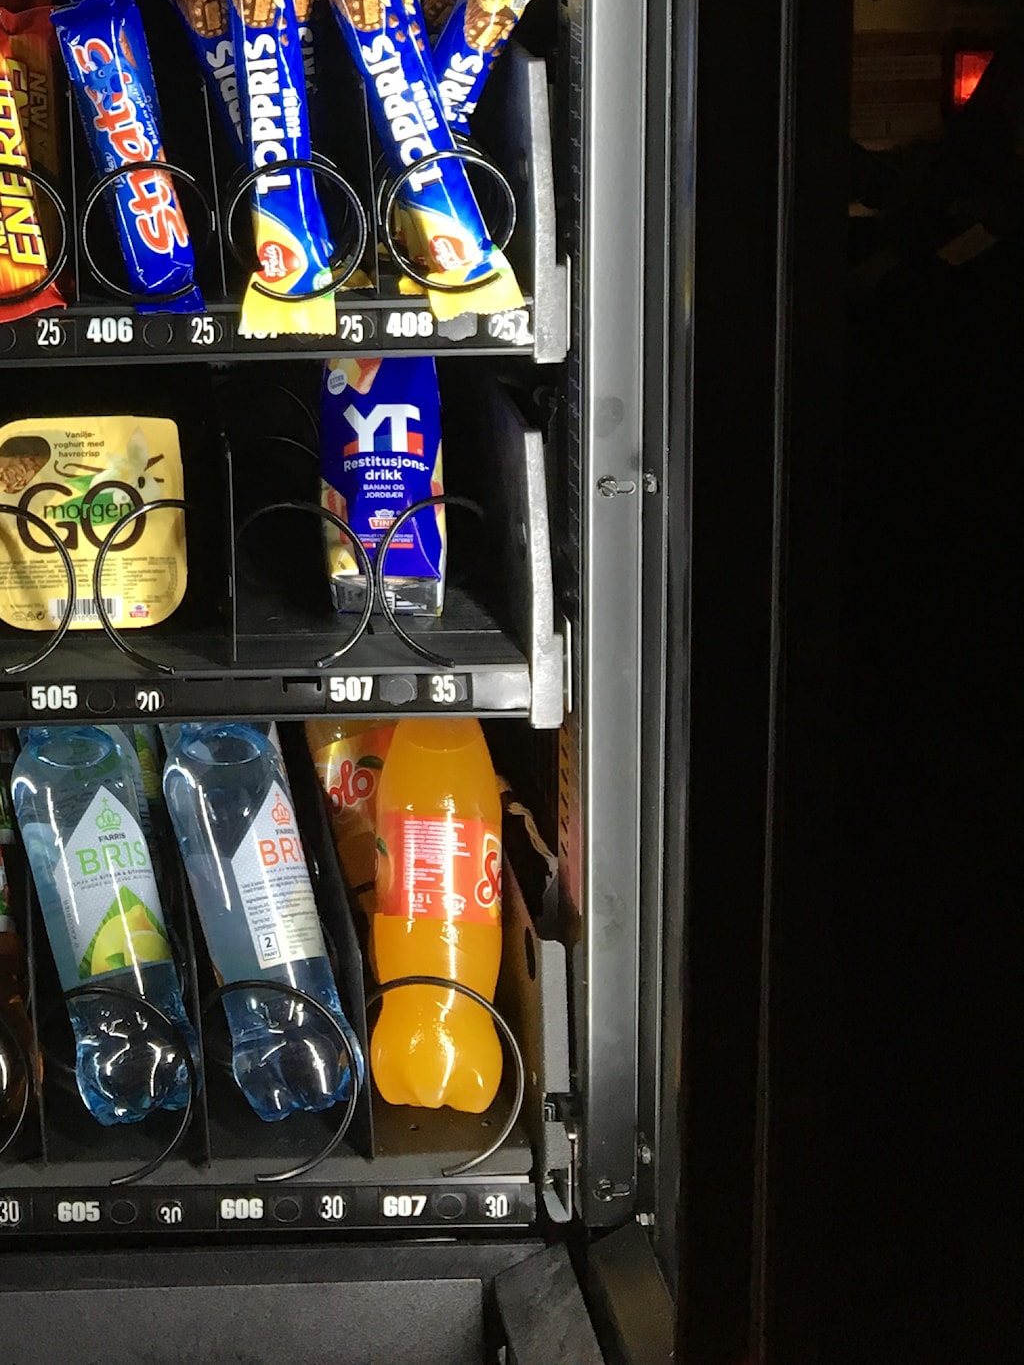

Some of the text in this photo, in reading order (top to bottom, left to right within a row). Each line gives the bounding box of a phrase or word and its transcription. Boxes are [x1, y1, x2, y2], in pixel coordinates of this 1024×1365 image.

[244, 33, 292, 195] TOPPRIS
[362, 33, 443, 193] TOPPRIS
[37, 318, 61, 346] 25
[86, 317, 133, 343] 406
[191, 316, 215, 345] 25
[339, 314, 364, 343] 25
[386, 311, 434, 338] 408
[343, 403, 421, 452] YT
[344, 456, 429, 472] Restitusjons-
[365, 469, 402, 481] drikk
[365, 491, 404, 499] JORDBÆR
[44, 501, 132, 524] morgen
[31, 685, 160, 712] 505 20
[329, 674, 456, 703] 507 35
[98, 833, 126, 842] FARRIS
[76, 841, 147, 876] BRIS
[265, 937, 272, 948] 2
[57, 1201, 182, 1224] 605 30
[220, 1195, 344, 1220] 606 30
[383, 1193, 508, 1218] 607 30
